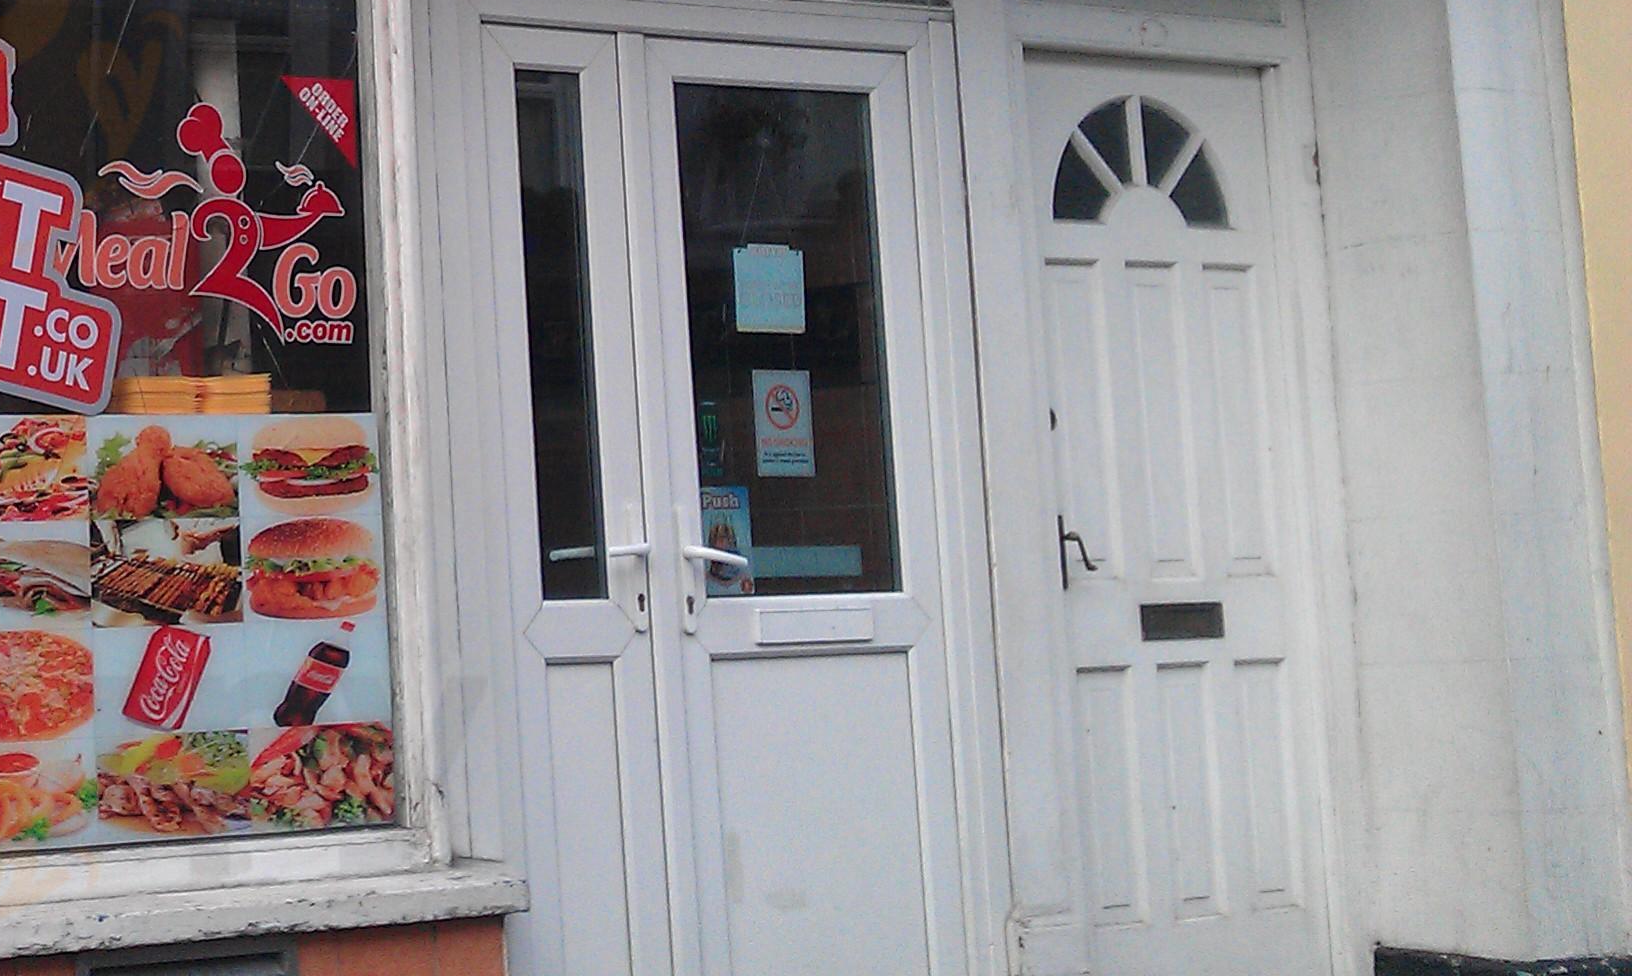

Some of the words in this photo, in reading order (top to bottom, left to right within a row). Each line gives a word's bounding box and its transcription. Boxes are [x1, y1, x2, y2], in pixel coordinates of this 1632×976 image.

[299, 87, 345, 143] ON-LINE
[311, 83, 349, 129] ORDER
[273, 242, 357, 319] Go
[32, 308, 100, 350] .CO
[285, 320, 354, 344] .com
[27, 348, 91, 392] .UK
[702, 493, 740, 509] Push
